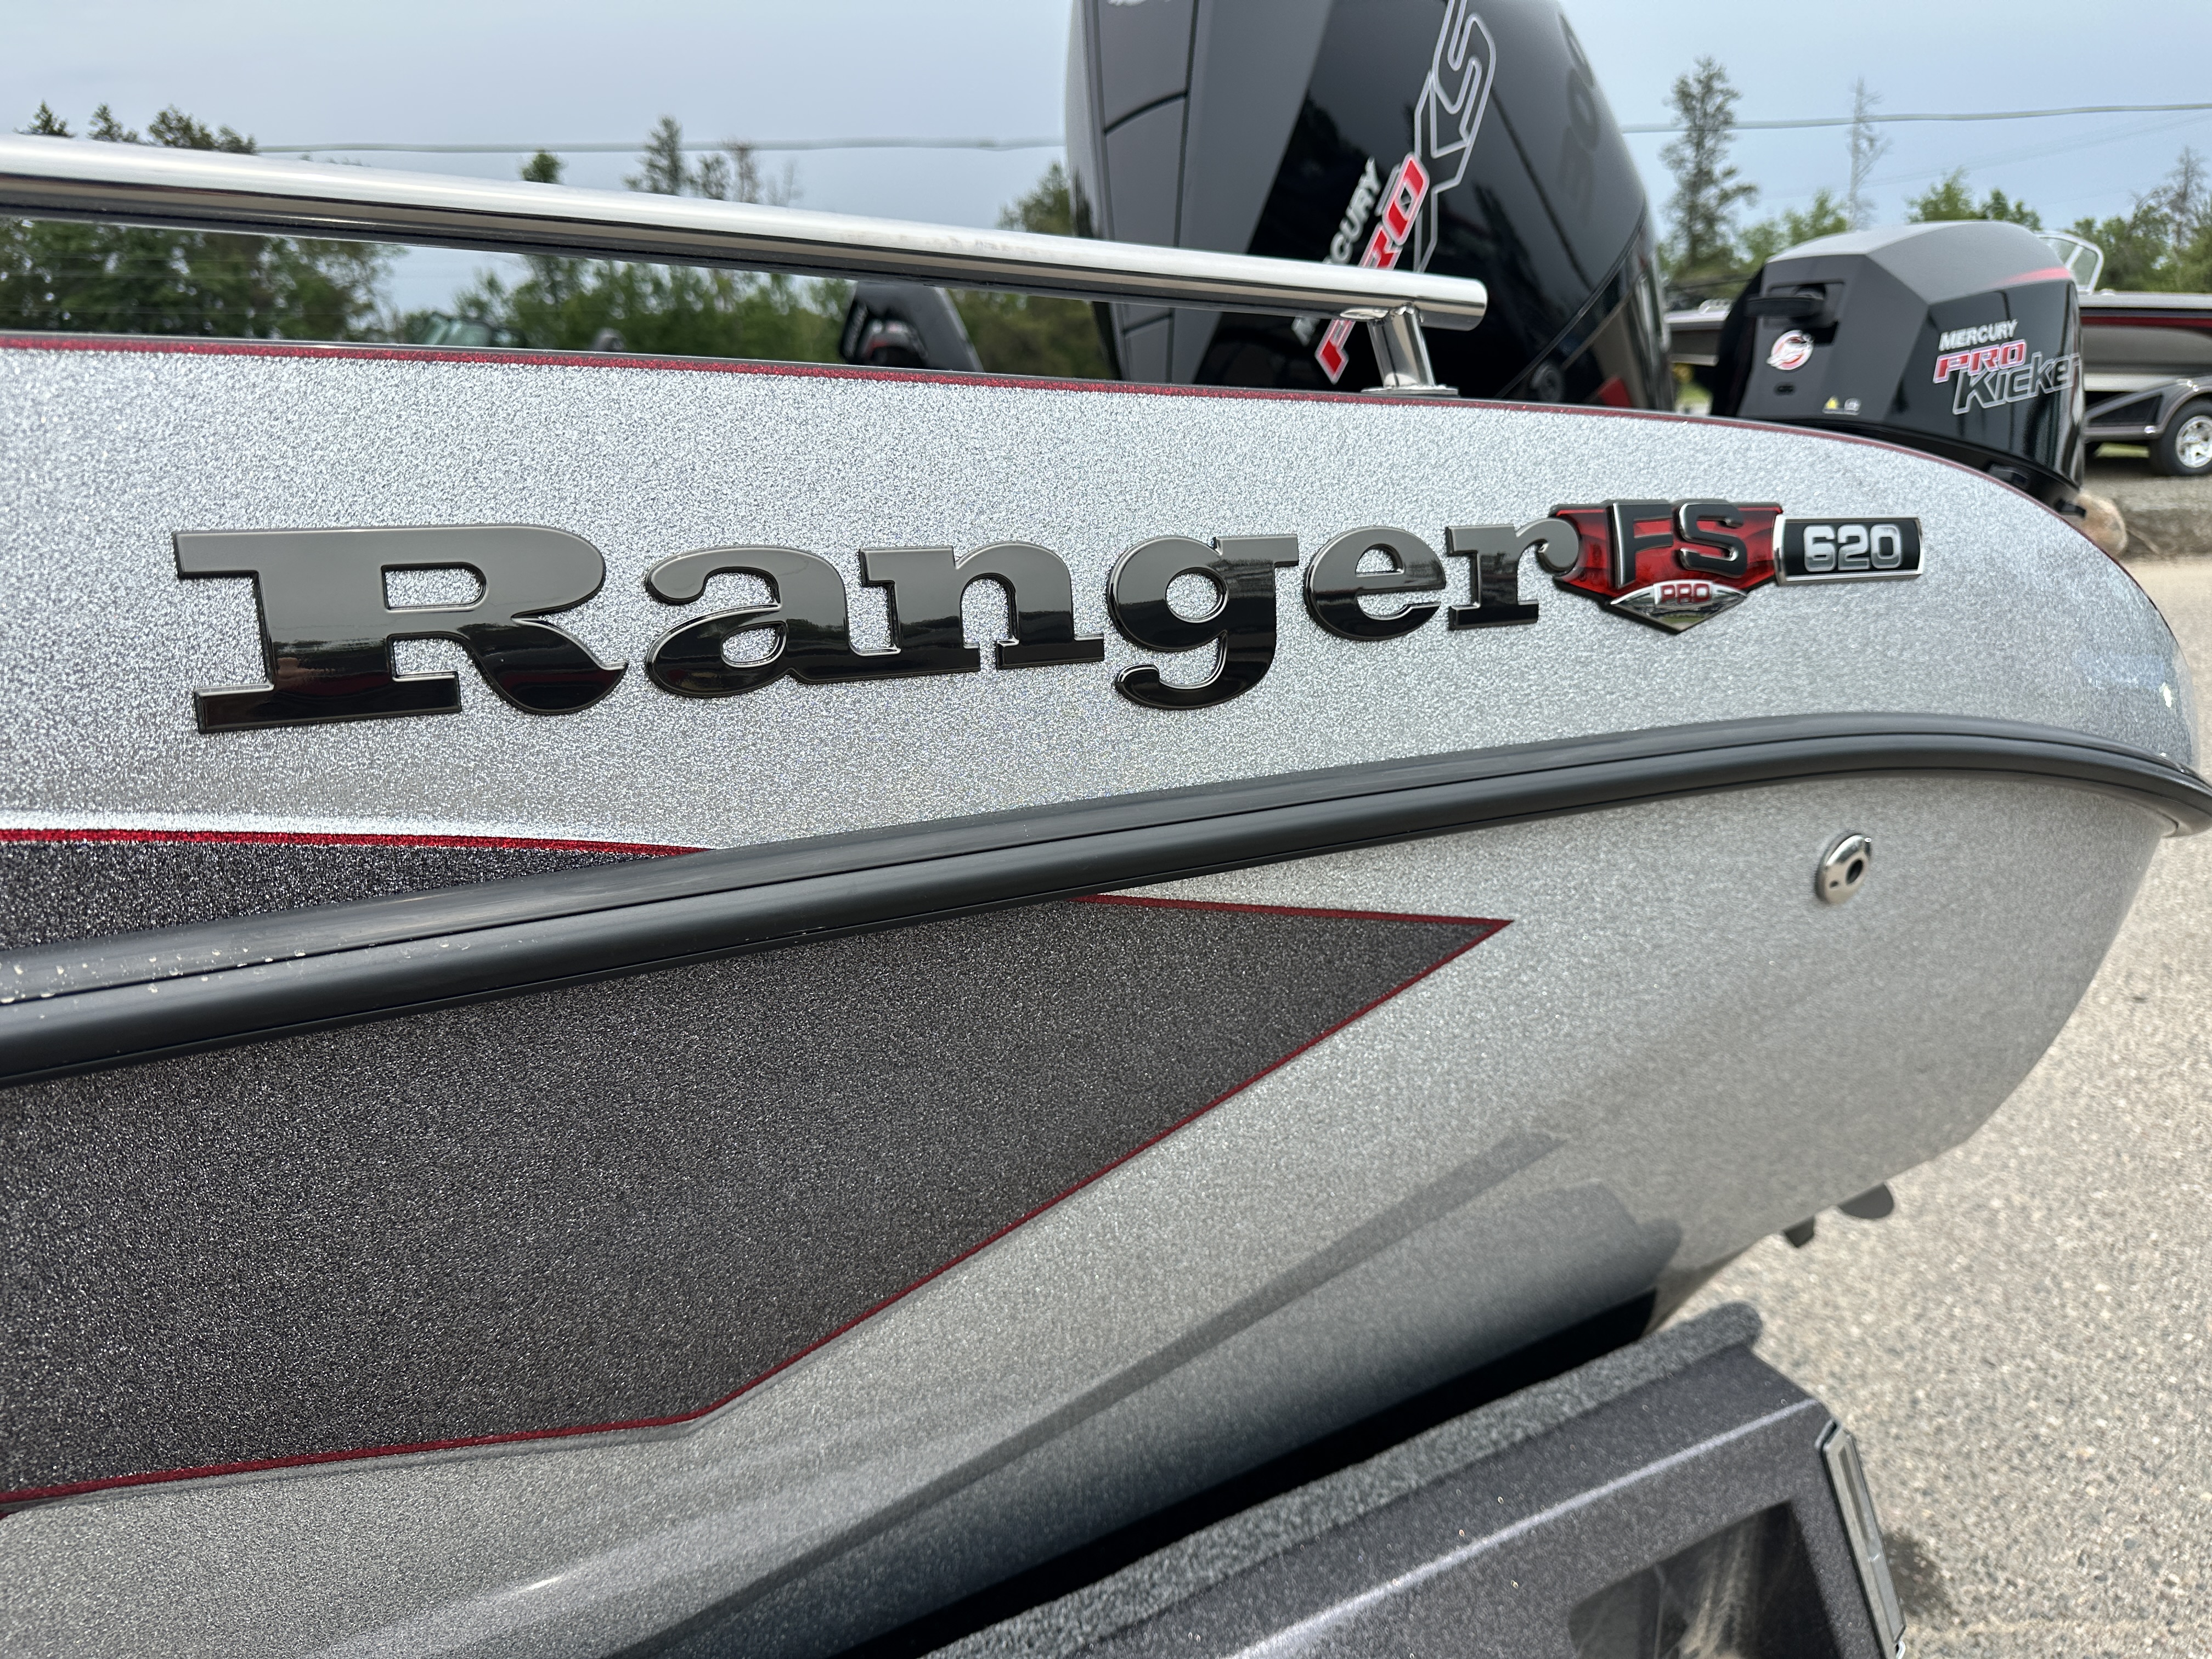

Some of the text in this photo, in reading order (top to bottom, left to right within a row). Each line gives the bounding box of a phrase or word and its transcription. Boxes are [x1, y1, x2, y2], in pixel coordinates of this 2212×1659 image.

[1290, 157, 1382, 347] MCURY
[1932, 338, 2027, 383] PRO
[1938, 317, 2018, 352] MERCURY
[1609, 499, 1903, 589] FS 620
[172, 517, 1580, 734] Ranger
[1660, 583, 1711, 603] PRO
